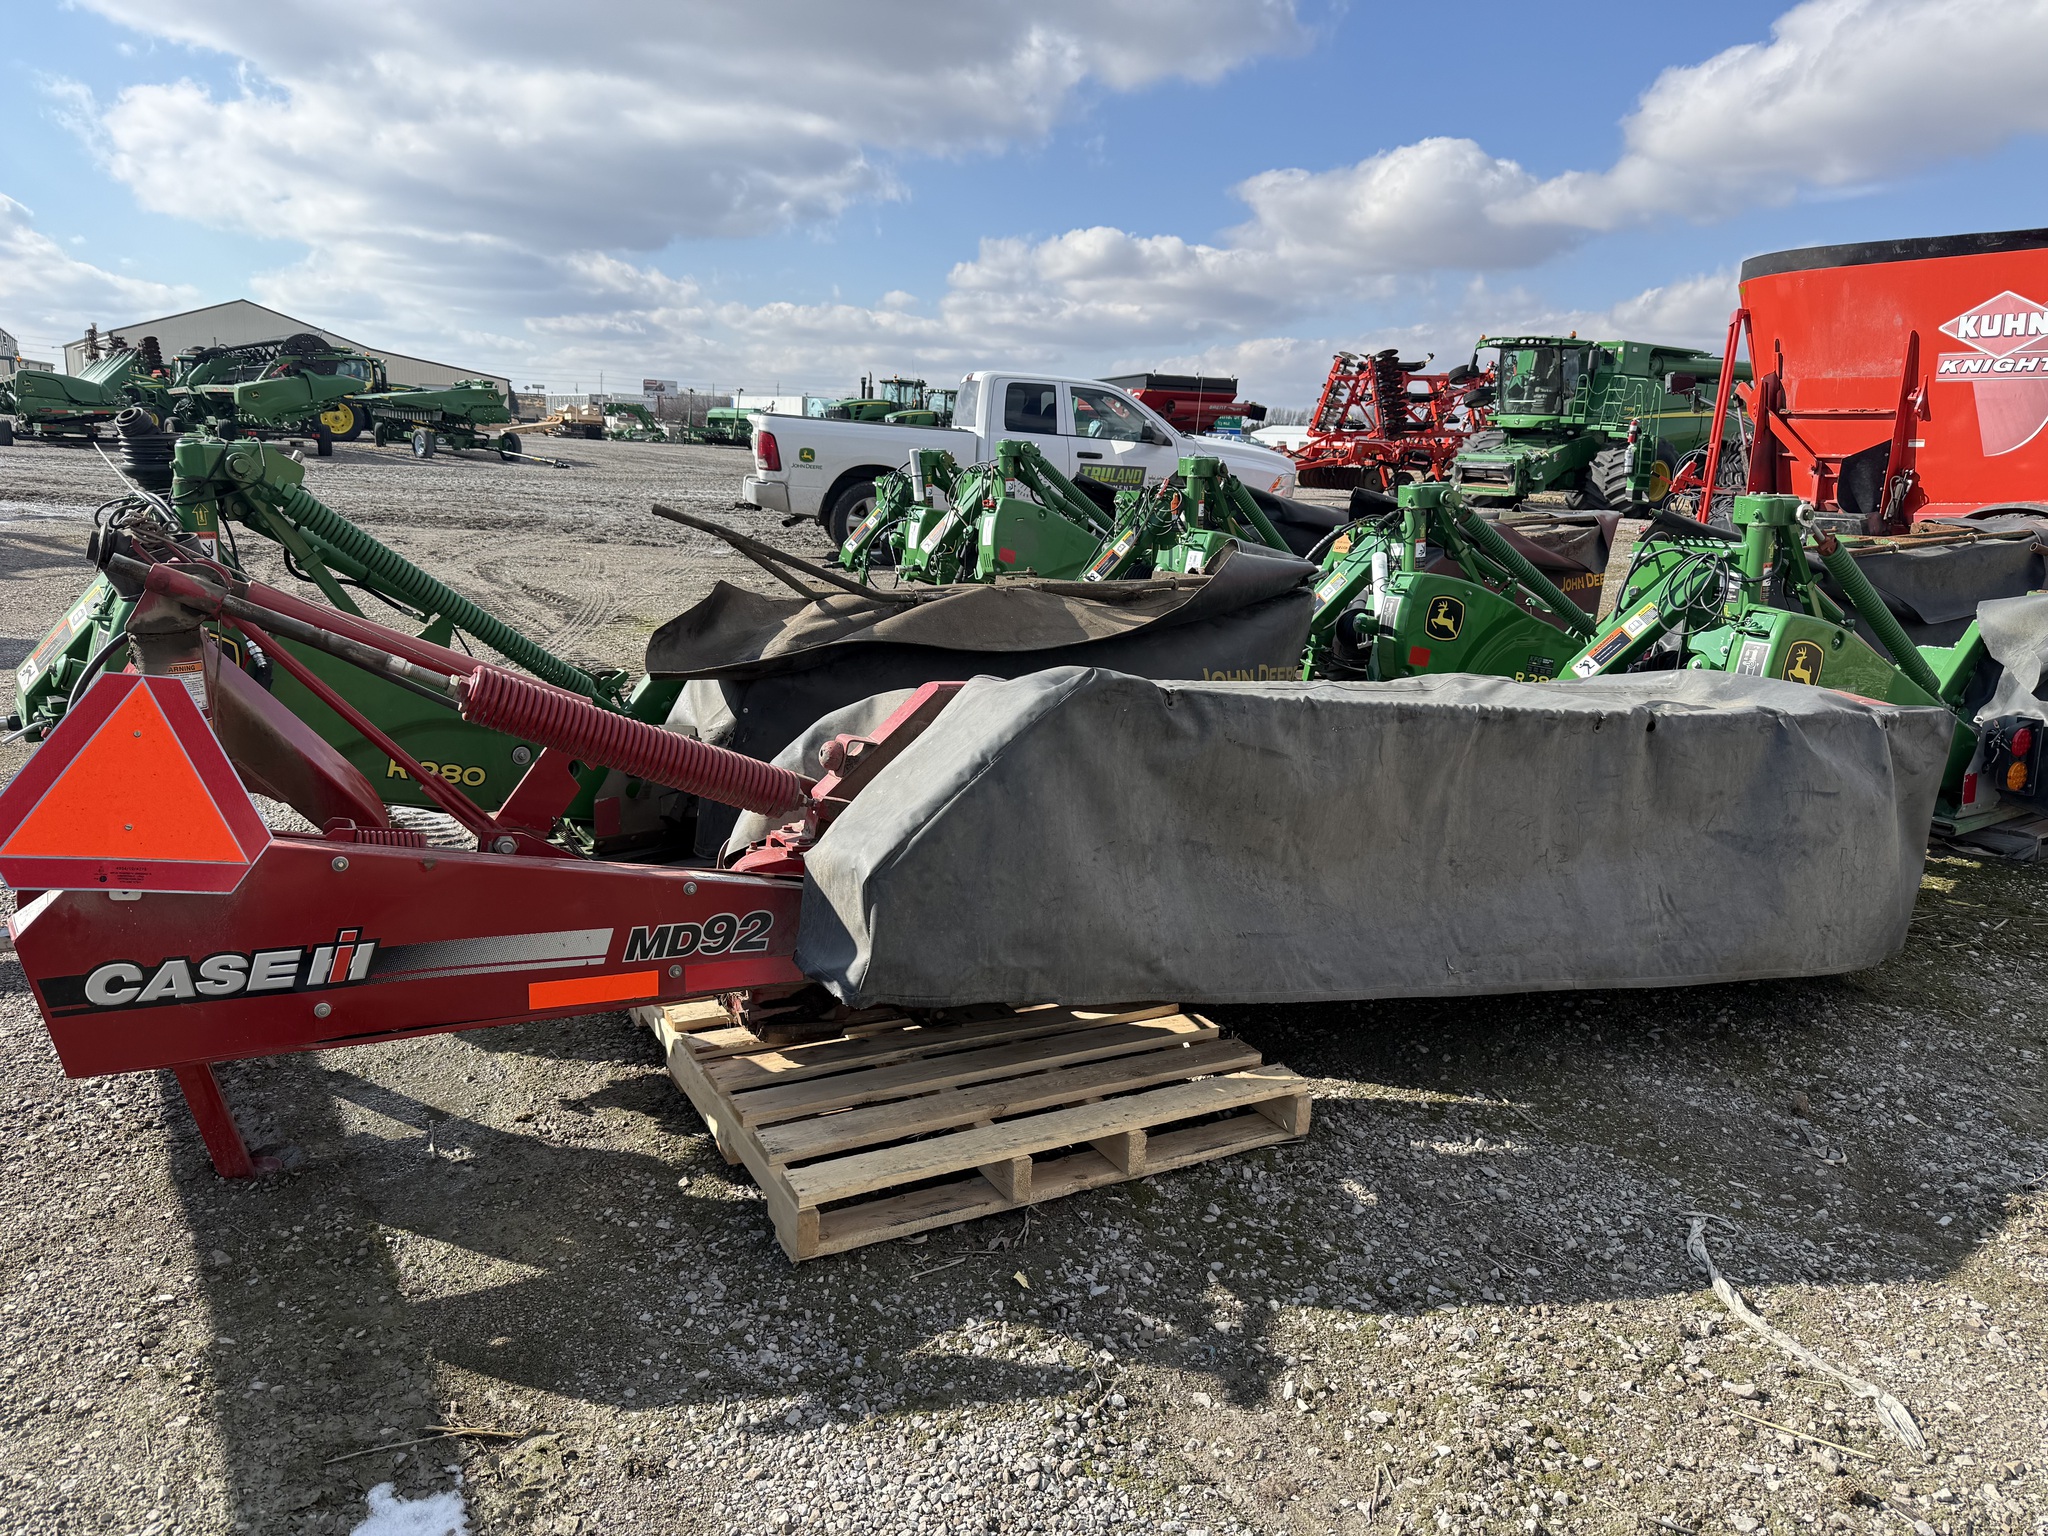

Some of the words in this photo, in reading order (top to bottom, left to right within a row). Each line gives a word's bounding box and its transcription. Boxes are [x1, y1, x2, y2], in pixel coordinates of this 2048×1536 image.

[1957, 312, 2048, 338] KUHN
[1082, 466, 1143, 485] TRULAND
[1561, 576, 1585, 592] JOHN
[168, 664, 196, 673] ARNING
[622, 909, 774, 963] MD92
[84, 949, 302, 1006] CASE
